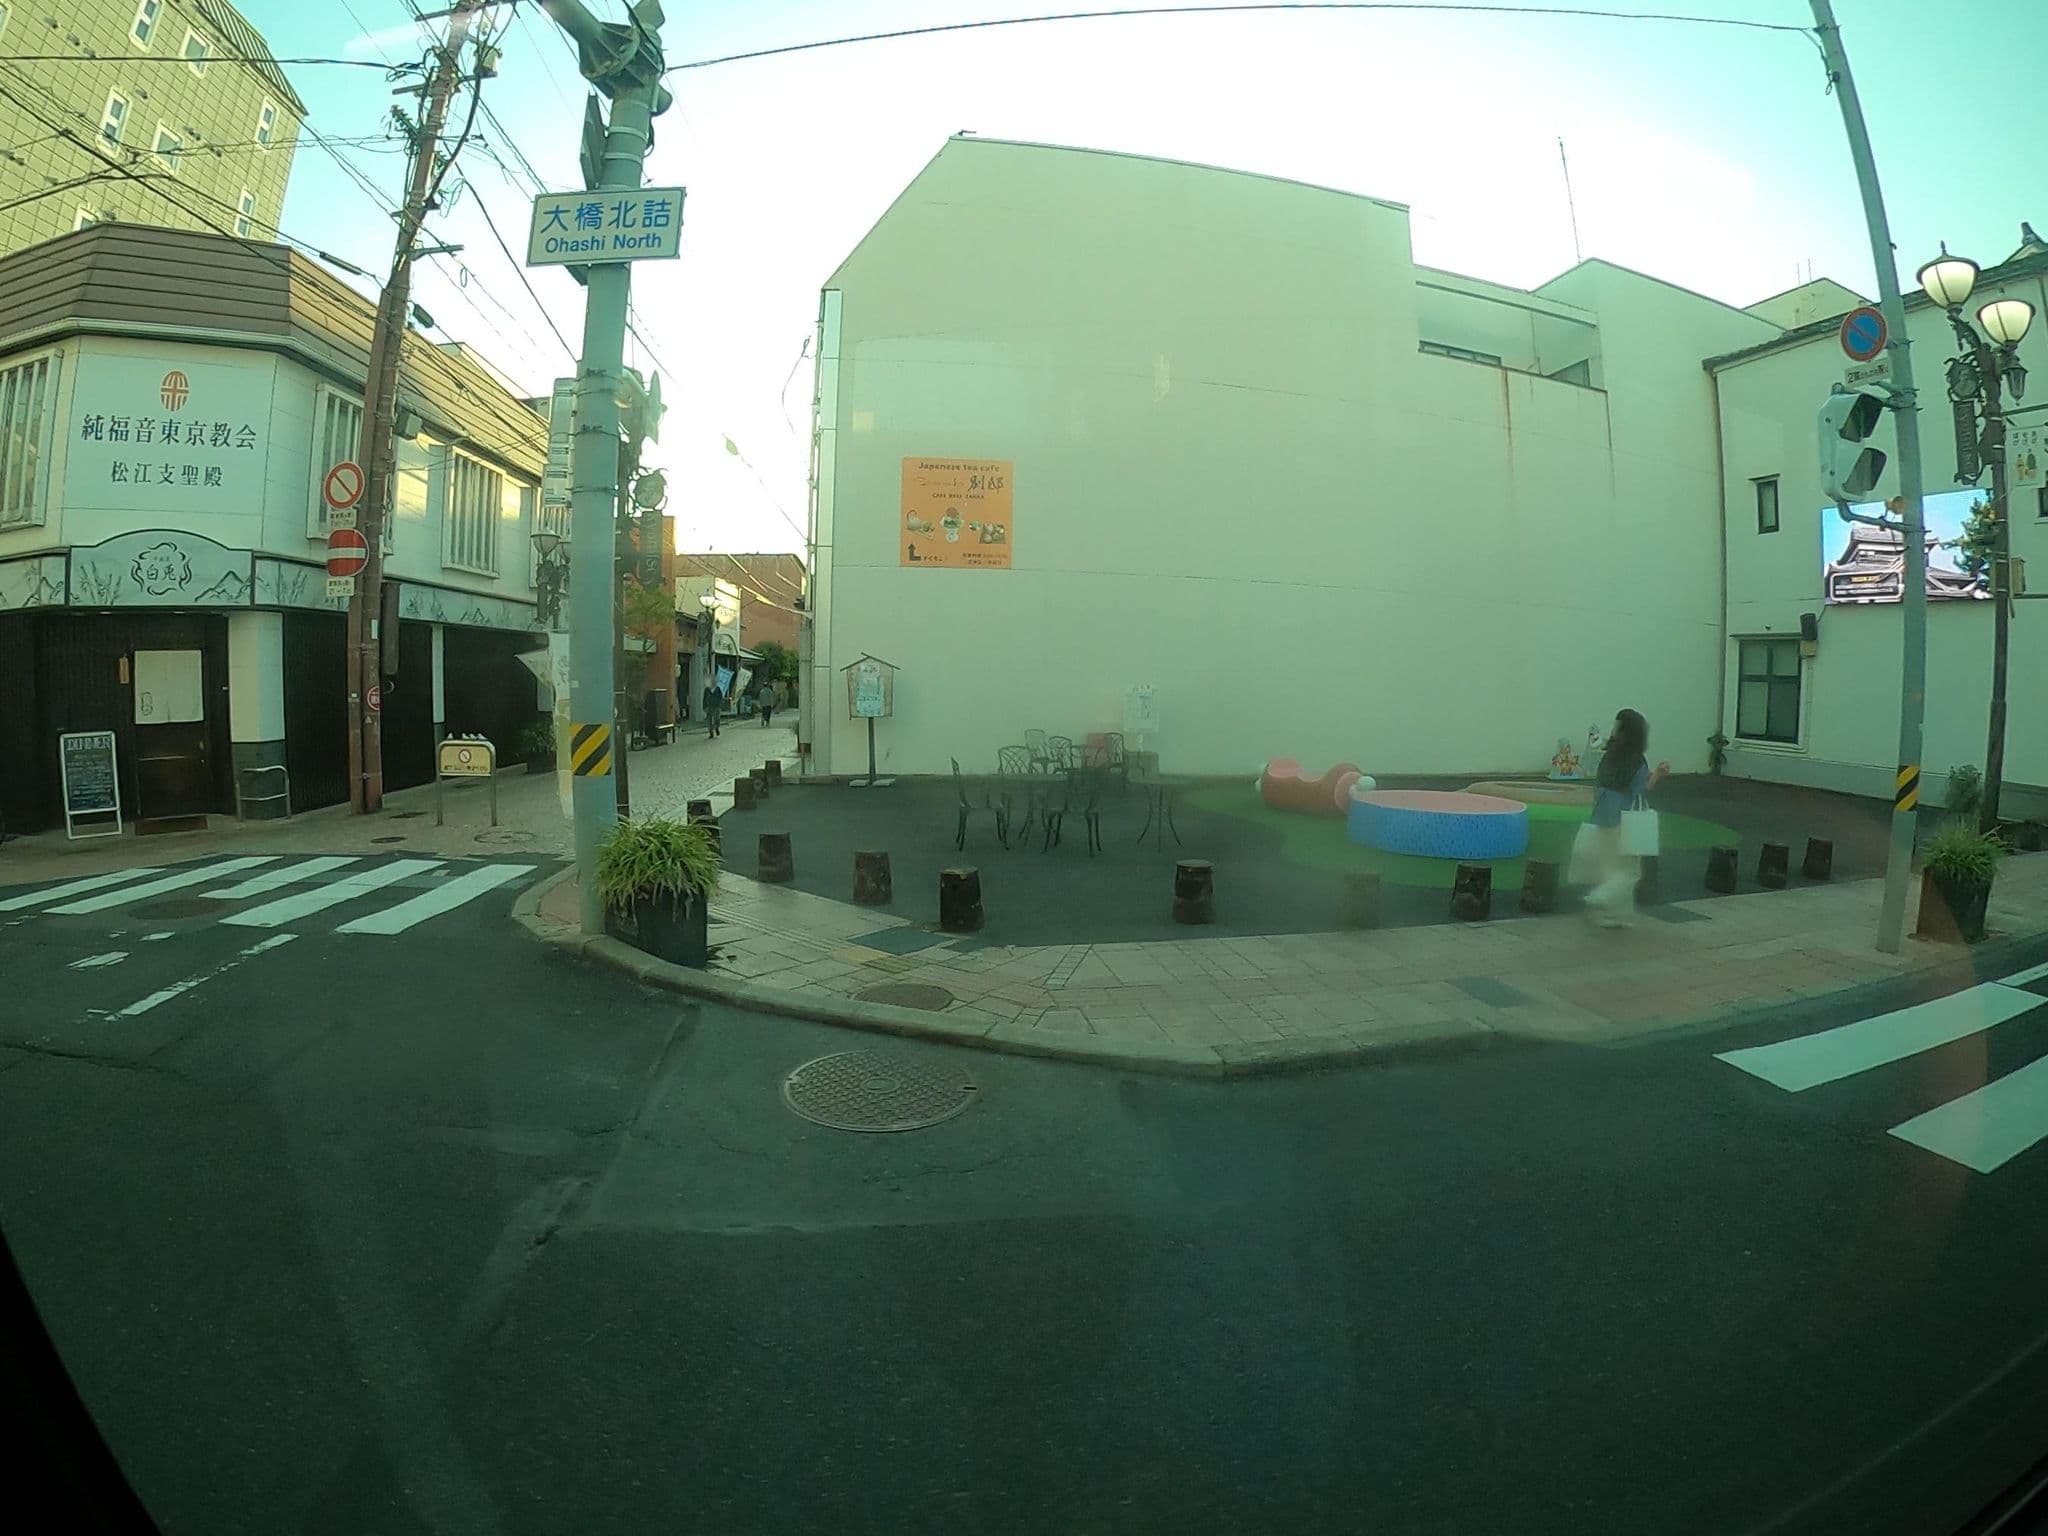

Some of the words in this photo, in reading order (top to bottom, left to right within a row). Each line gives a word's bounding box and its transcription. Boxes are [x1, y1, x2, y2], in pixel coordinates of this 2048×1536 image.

[540, 199, 672, 233] 大橋北詰
[545, 236, 605, 254] Ohashi
[613, 233, 661, 250] North
[81, 413, 257, 450] 純福音東京教会
[111, 461, 223, 488] 松江支聖殿
[918, 462, 961, 471] Japanese
[980, 464, 1000, 472] cafe
[67, 737, 111, 751] DINNER
